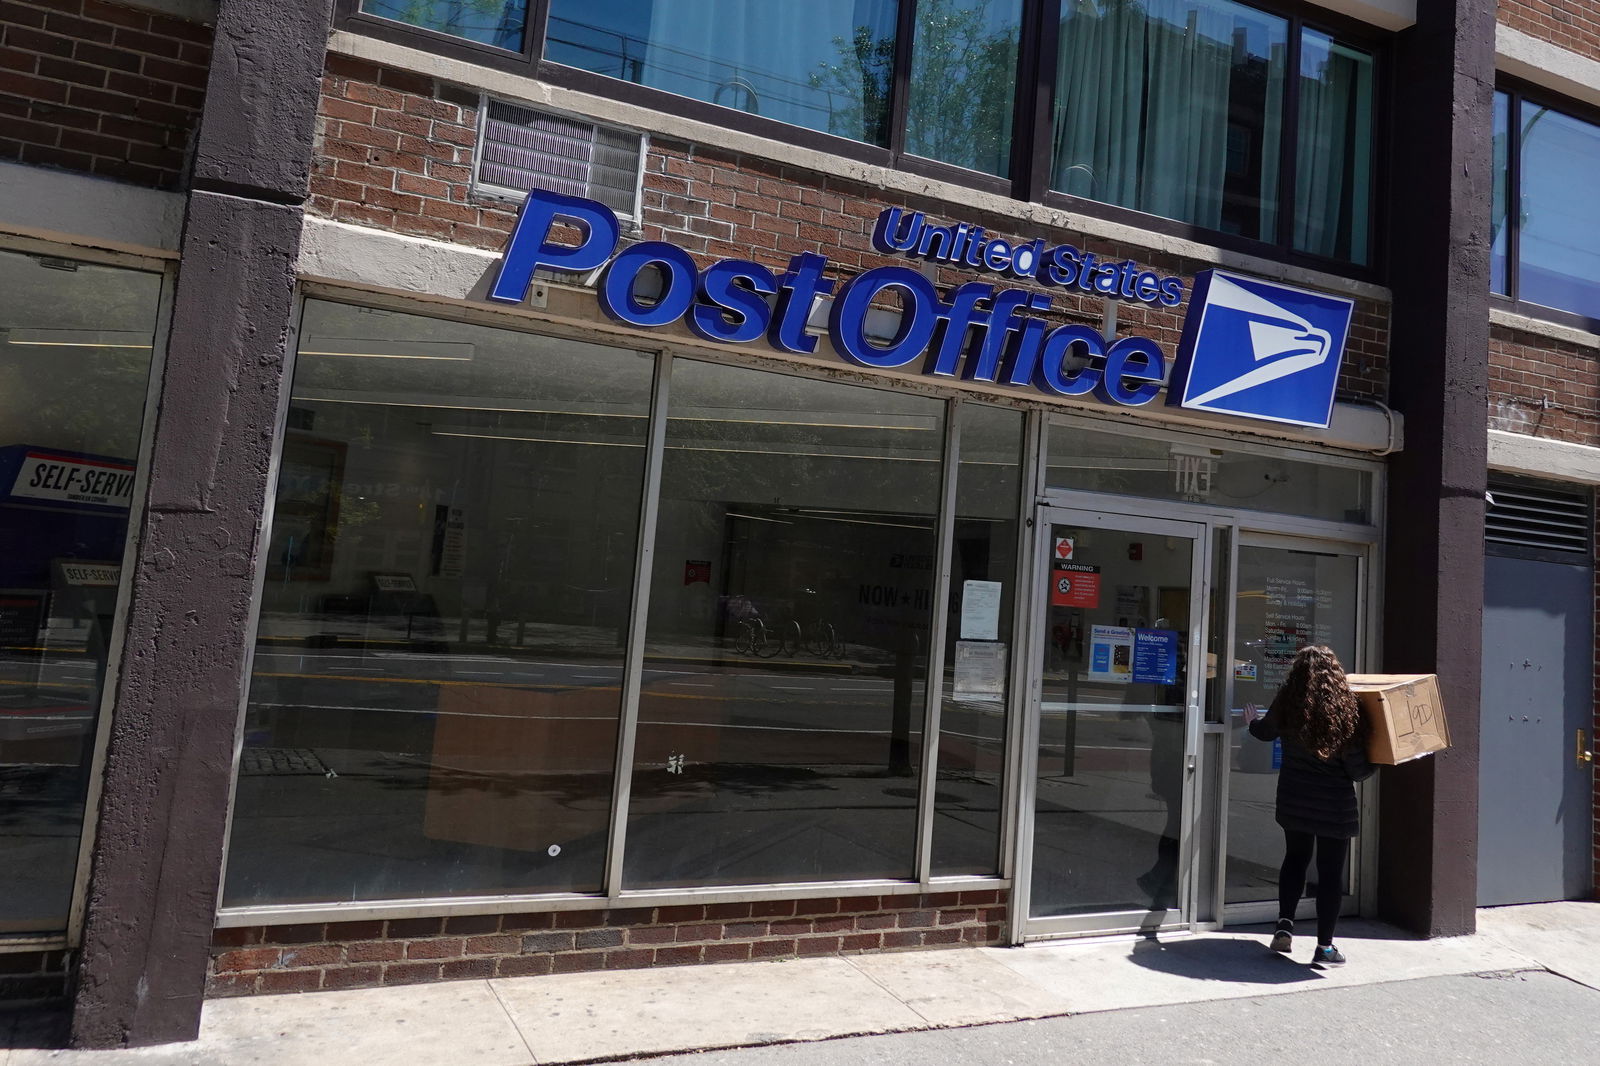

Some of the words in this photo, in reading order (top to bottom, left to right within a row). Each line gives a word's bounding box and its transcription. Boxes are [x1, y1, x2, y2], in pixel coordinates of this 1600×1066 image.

[873, 204, 1049, 284] United
[1046, 242, 1185, 309] States
[30, 463, 134, 498] SELF-SERVI
[66, 567, 119, 582] SELF-SERVI
[1061, 563, 1094, 573] WARNING
[858, 584, 898, 608] NOW
[1138, 633, 1169, 643] Welcome
